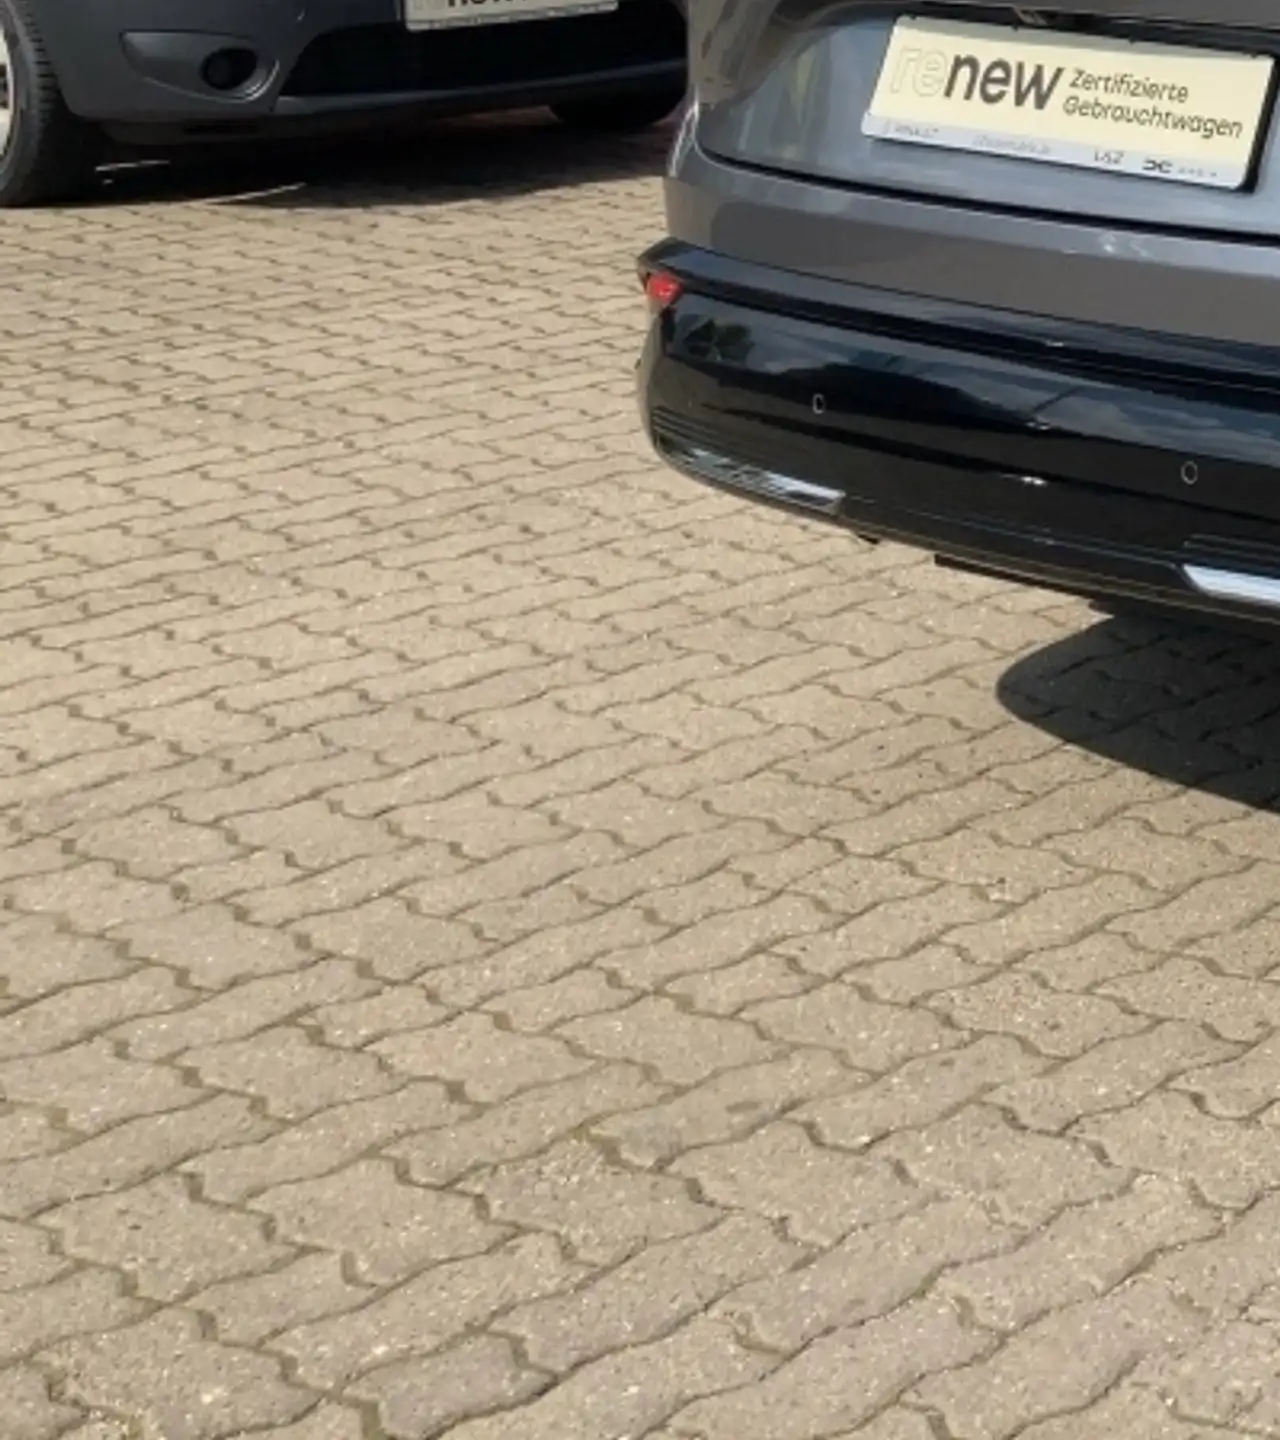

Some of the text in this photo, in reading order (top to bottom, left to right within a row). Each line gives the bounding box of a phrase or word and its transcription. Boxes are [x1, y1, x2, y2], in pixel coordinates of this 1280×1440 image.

[890, 47, 1065, 111] renew
[1068, 68, 1190, 104] Zertifizierte
[1062, 95, 1244, 140] Gebrauchtwagen
